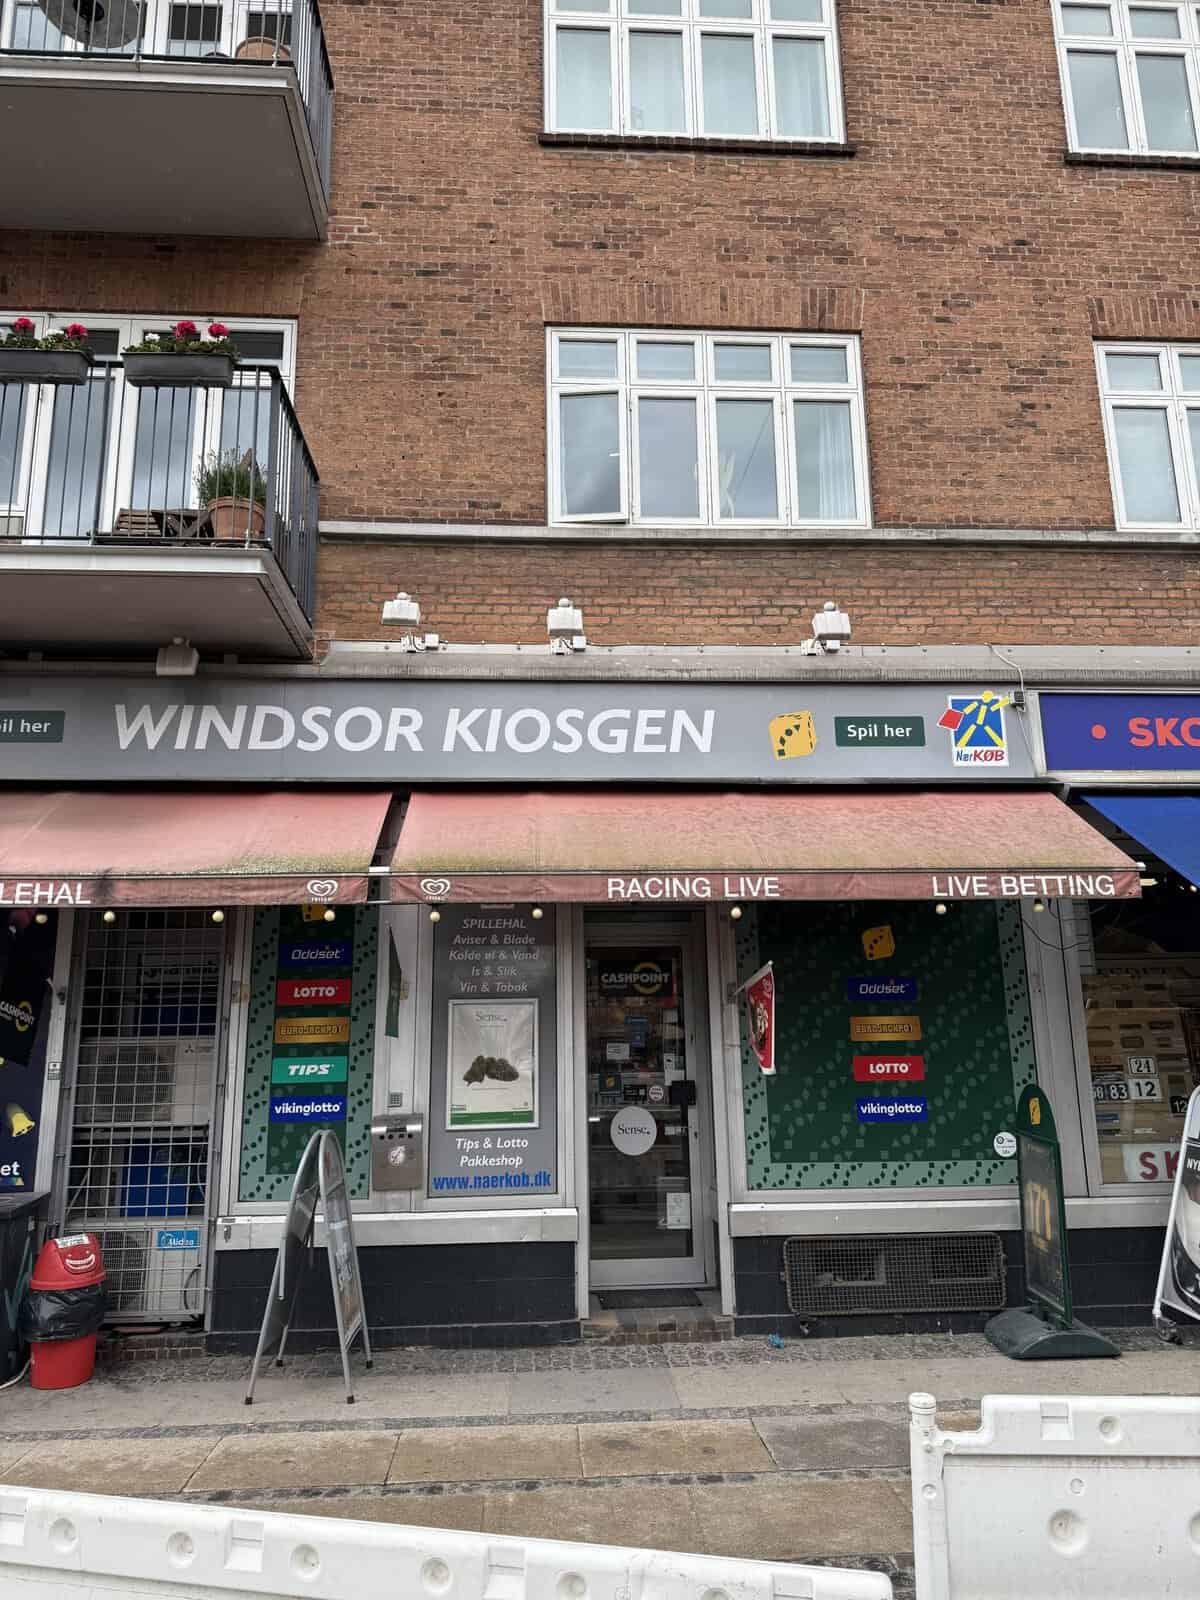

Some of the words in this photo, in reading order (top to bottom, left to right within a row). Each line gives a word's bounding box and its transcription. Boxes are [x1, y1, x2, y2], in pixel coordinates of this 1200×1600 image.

[0, 718, 13, 733] il
[20, 718, 51, 733] her
[114, 704, 424, 752] WINDSOR
[442, 708, 716, 753] KIOSGEN
[847, 723, 878, 741] Spil
[884, 723, 912, 737] her
[607, 877, 712, 899] RACING
[724, 876, 780, 897] LIVE
[932, 876, 989, 897] LIVE
[1000, 875, 1115, 896] BETTING
[463, 919, 527, 929] SPILLEHAL
[453, 934, 487, 945] Aviser
[490, 934, 500, 945] &
[503, 934, 536, 945] Blade
[291, 949, 341, 960] Oddset
[449, 949, 481, 961] Kolde
[511, 948, 540, 961] Vand
[472, 966, 481, 977] Is
[496, 965, 518, 977] Slik
[600, 972, 670, 985] CASHPOINT
[293, 986, 336, 998] LOTTO
[459, 981, 478, 993] Vin
[480, 981, 490, 993] &
[496, 980, 529, 993] Tabak
[859, 983, 906, 994] Oddset
[288, 1064, 330, 1076] TIPS
[869, 1063, 909, 1074] LOTTO
[1109, 1083, 1129, 1100] 83
[1135, 1081, 1157, 1097] 12
[275, 1101, 340, 1116] vikinglotto
[861, 1102, 922, 1116] vikinglotto
[455, 1136, 480, 1152] Tips
[483, 1137, 493, 1149] &
[497, 1136, 529, 1149] Lotto
[460, 1154, 523, 1168] Pakkeshop
[432, 1170, 551, 1190] www.naerkob.dk
